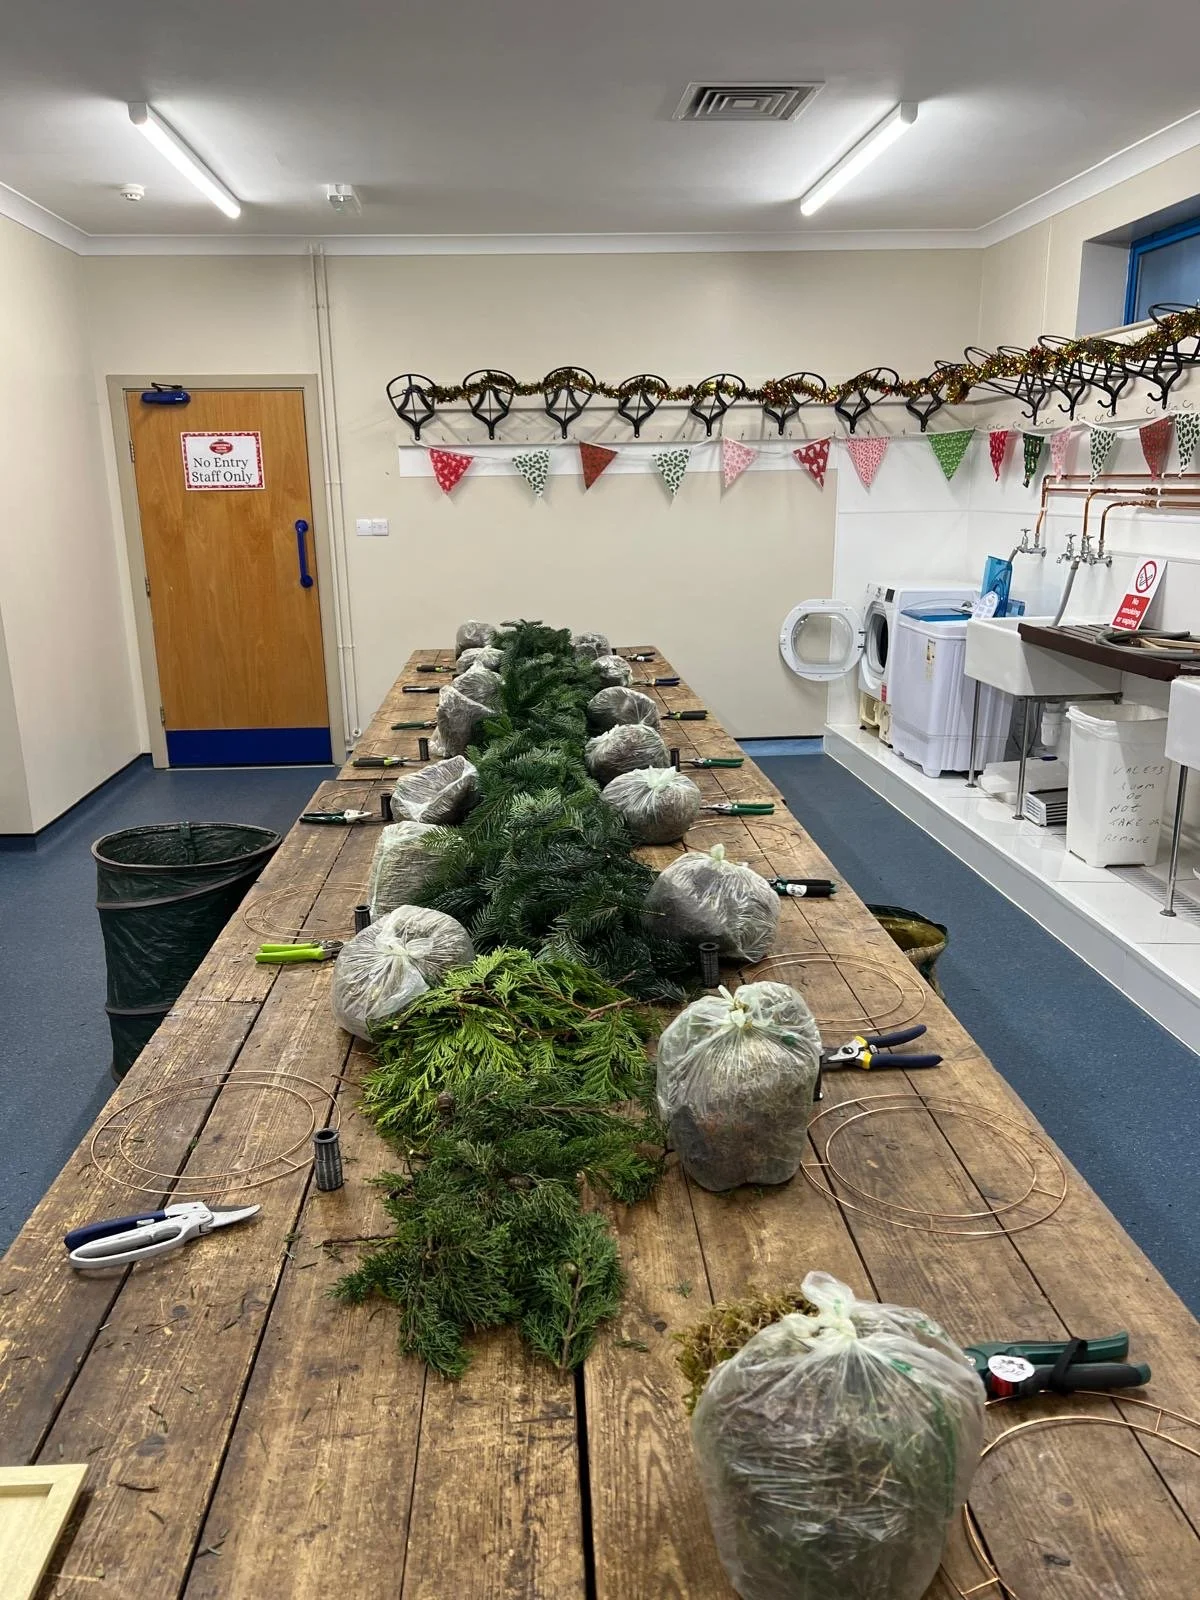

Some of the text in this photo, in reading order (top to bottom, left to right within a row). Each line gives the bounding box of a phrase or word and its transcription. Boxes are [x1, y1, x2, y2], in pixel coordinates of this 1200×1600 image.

[193, 457, 249, 470] No Entry
[191, 469, 253, 484] Staff Only
[1132, 597, 1140, 605] No
[1121, 607, 1141, 617] smoking
